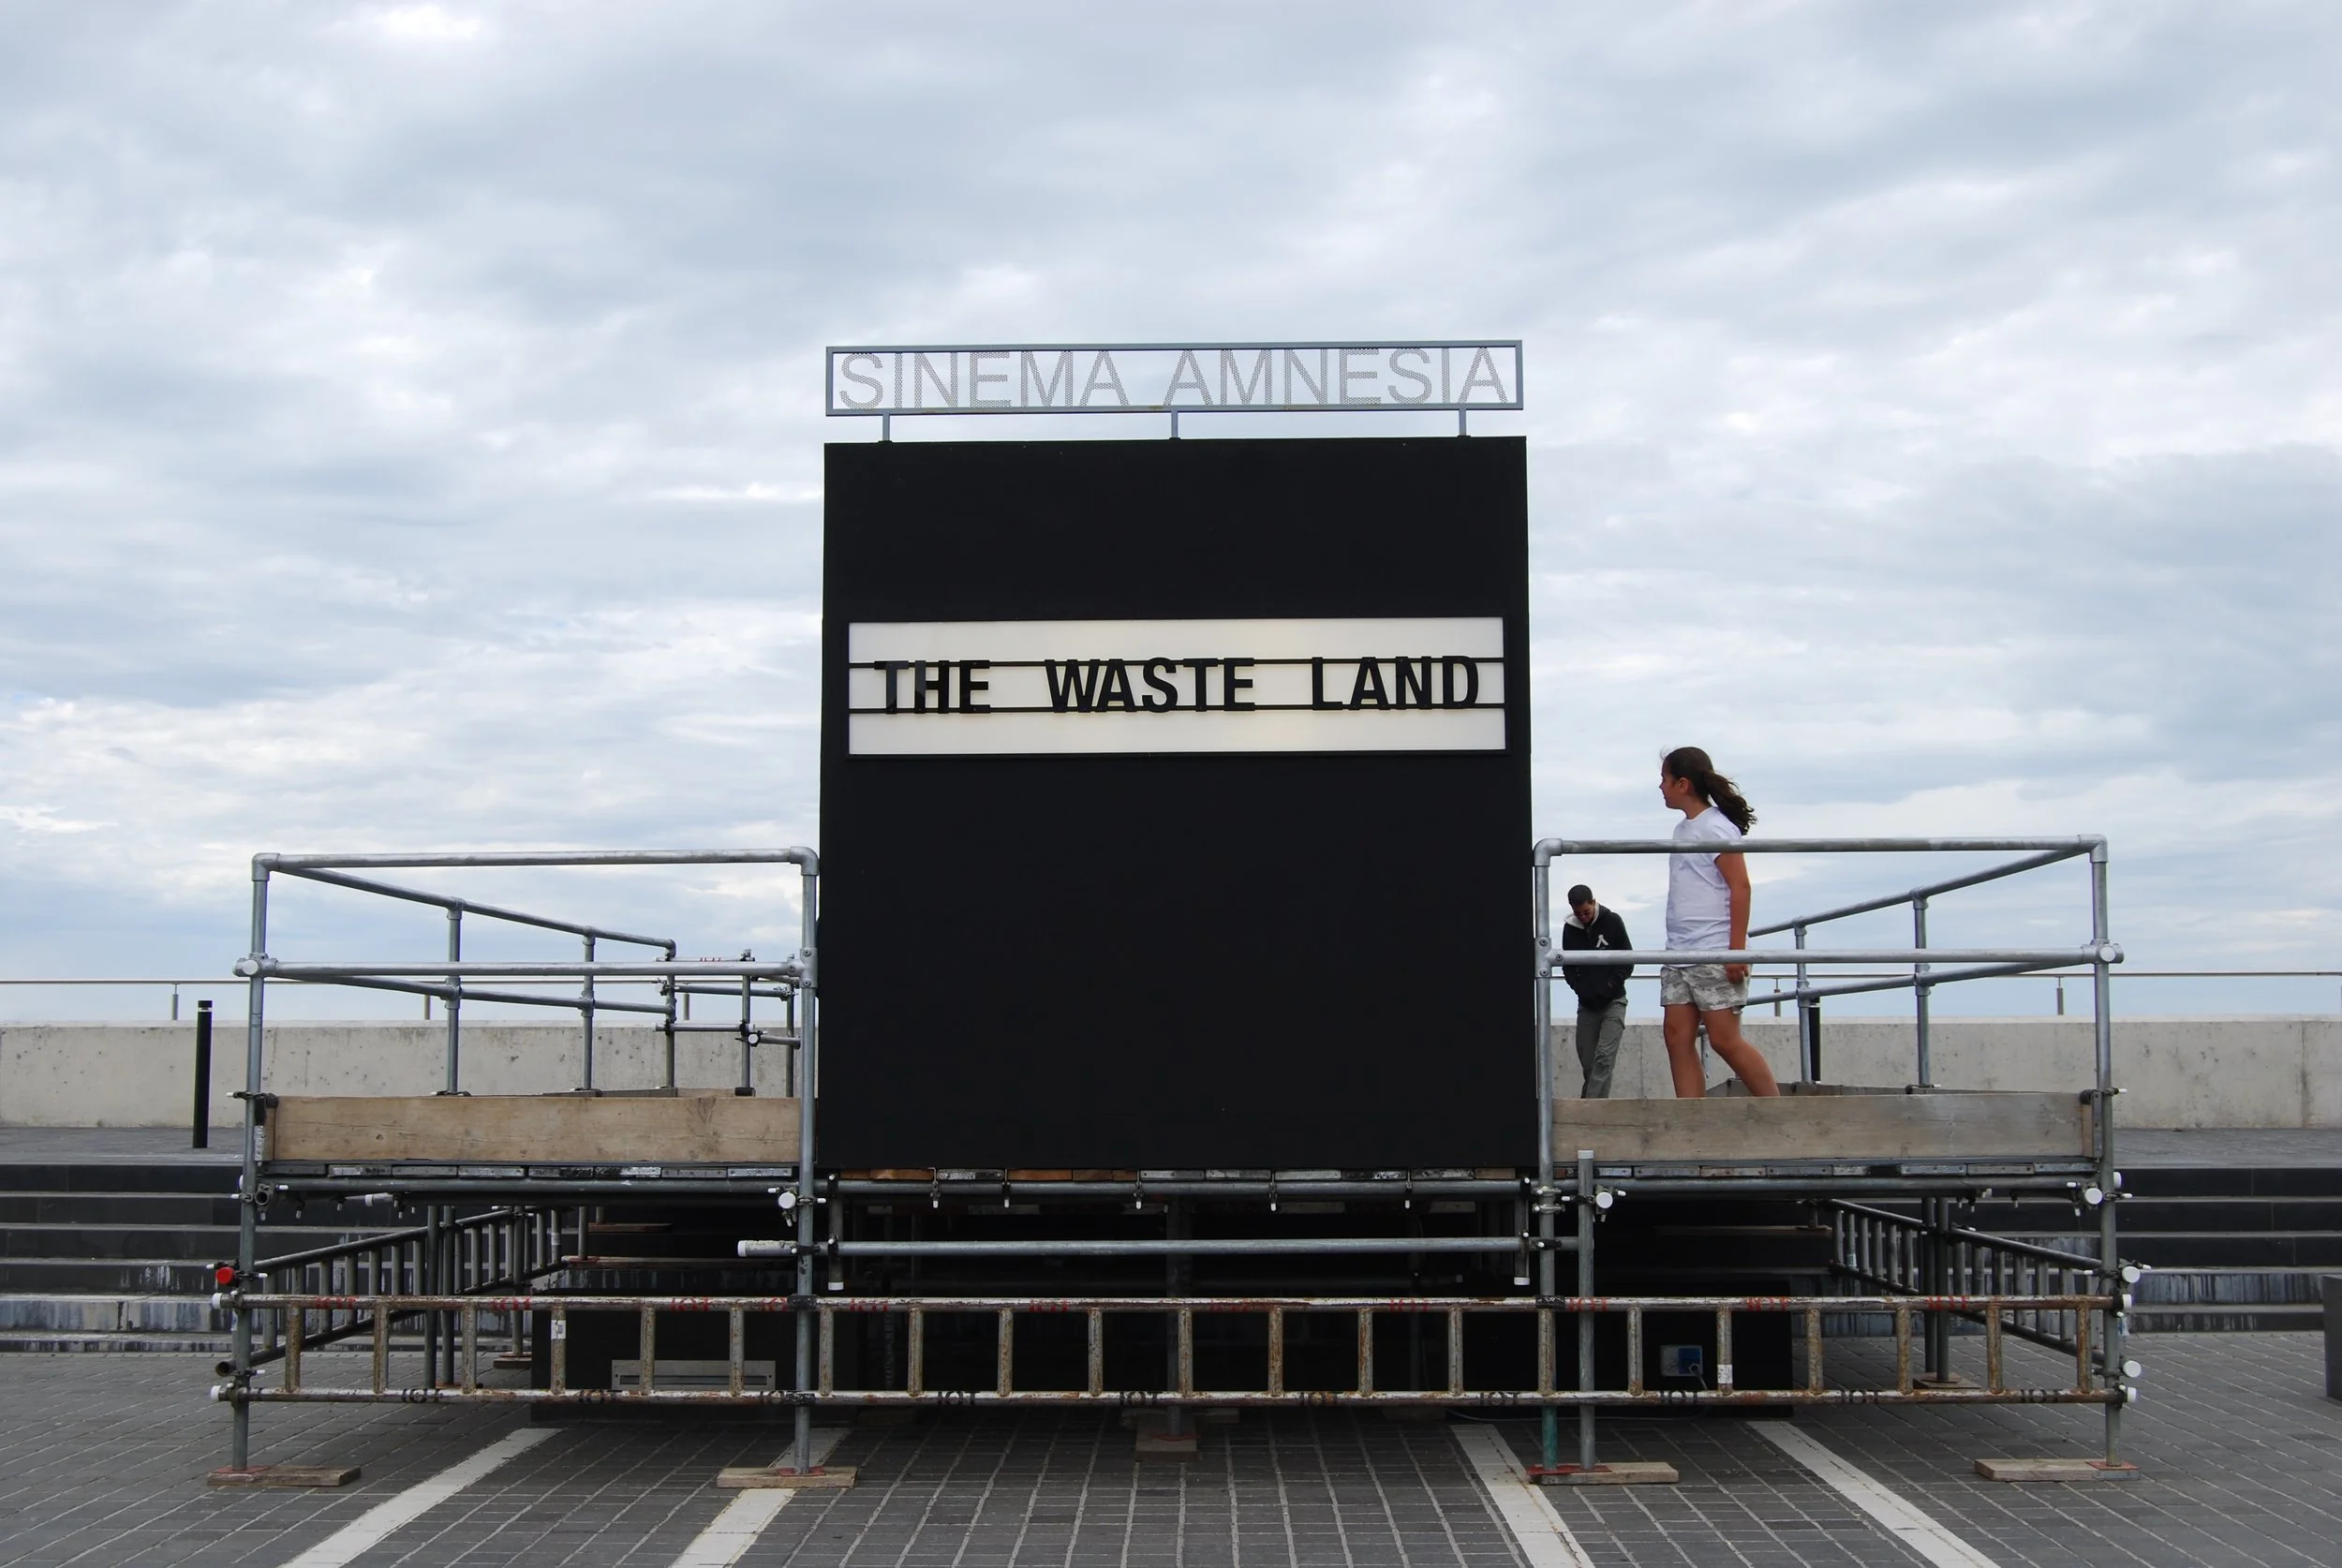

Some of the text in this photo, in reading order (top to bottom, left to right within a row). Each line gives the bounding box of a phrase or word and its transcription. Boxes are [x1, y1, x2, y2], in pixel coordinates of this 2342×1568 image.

[838, 347, 1509, 410] SINEMA AMNESIA
[875, 655, 1479, 715] THE WASTE LAND
